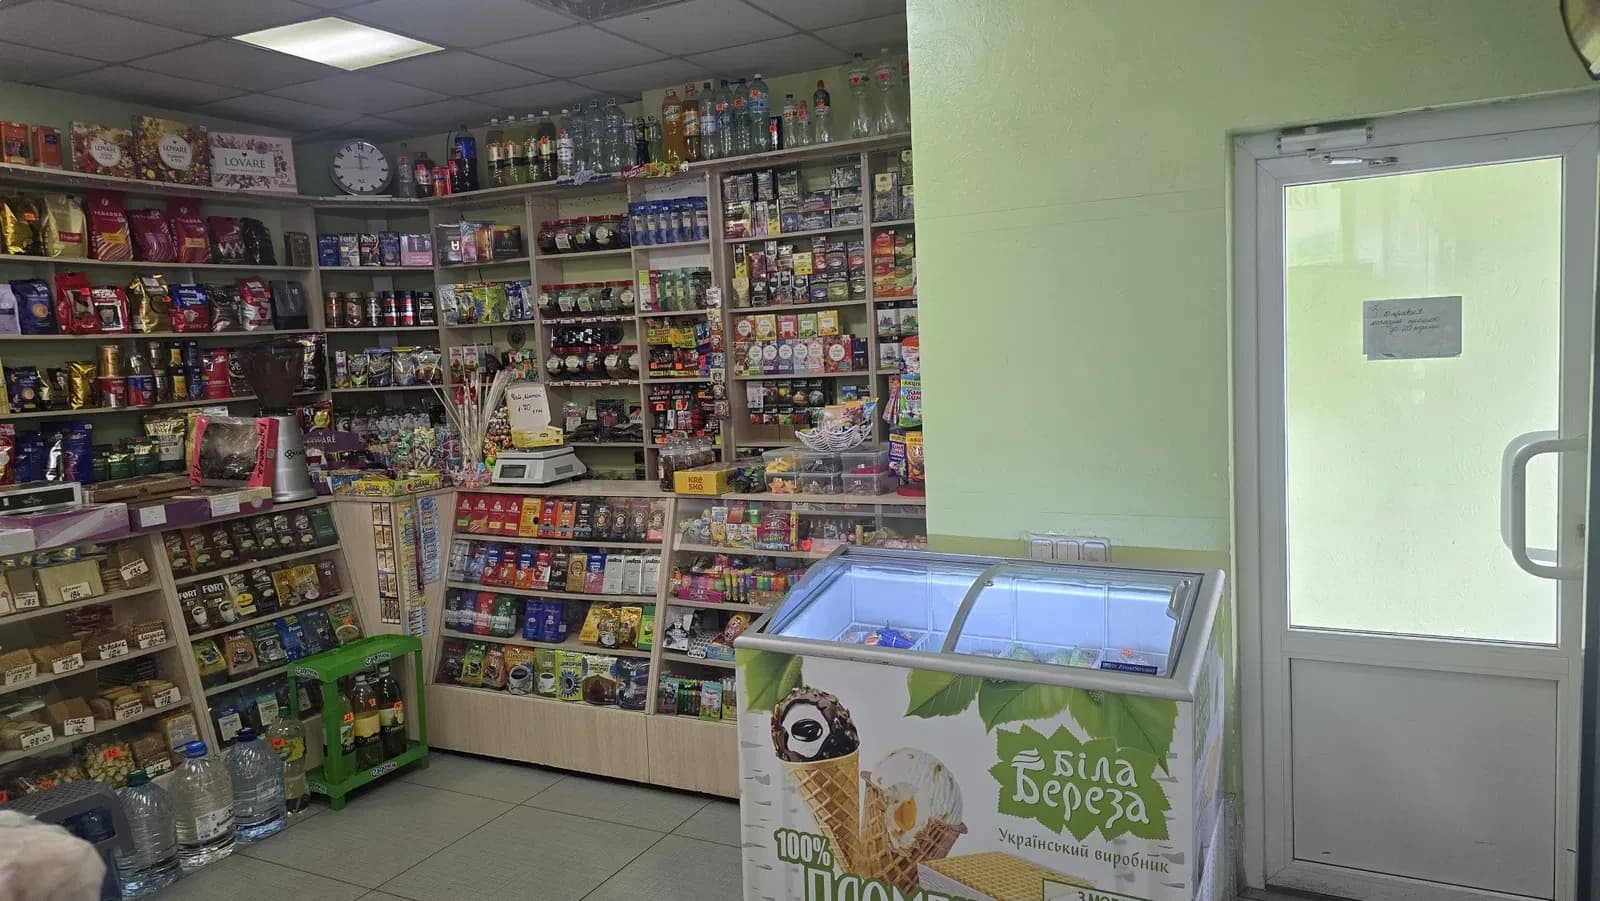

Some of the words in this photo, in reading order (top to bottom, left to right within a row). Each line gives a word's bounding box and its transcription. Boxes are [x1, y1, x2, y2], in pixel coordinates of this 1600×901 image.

[1011, 748, 1150, 829] Береза
[1052, 749, 1138, 788] Біла
[776, 830, 831, 866] 100%
[998, 827, 1090, 858] Український
[1094, 848, 1170, 874] виробник
